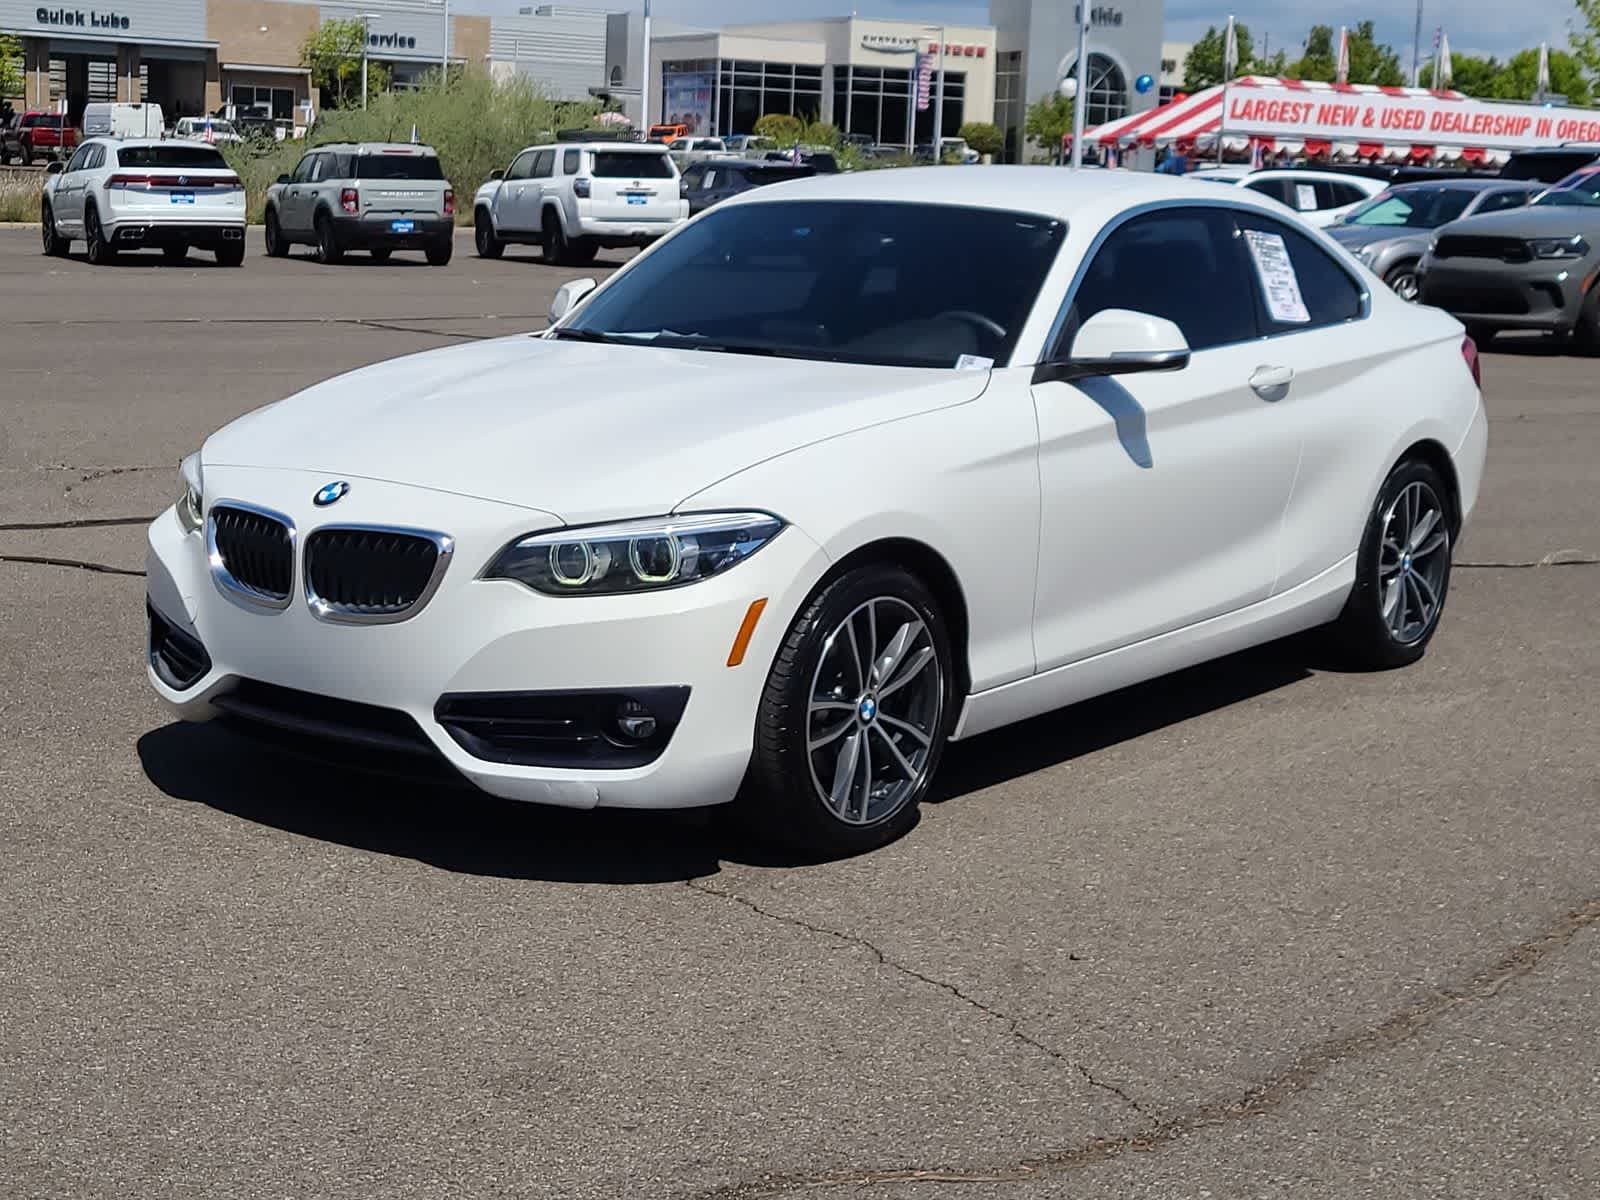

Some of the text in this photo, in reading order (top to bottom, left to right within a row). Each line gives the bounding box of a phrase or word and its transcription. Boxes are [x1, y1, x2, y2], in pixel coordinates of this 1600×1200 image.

[36, 7, 130, 29] Quick Lube
[1075, 4, 1123, 27] Lthia
[1229, 97, 1600, 142] LARGEST NEW & USED DEALERSHIP IN OREG
